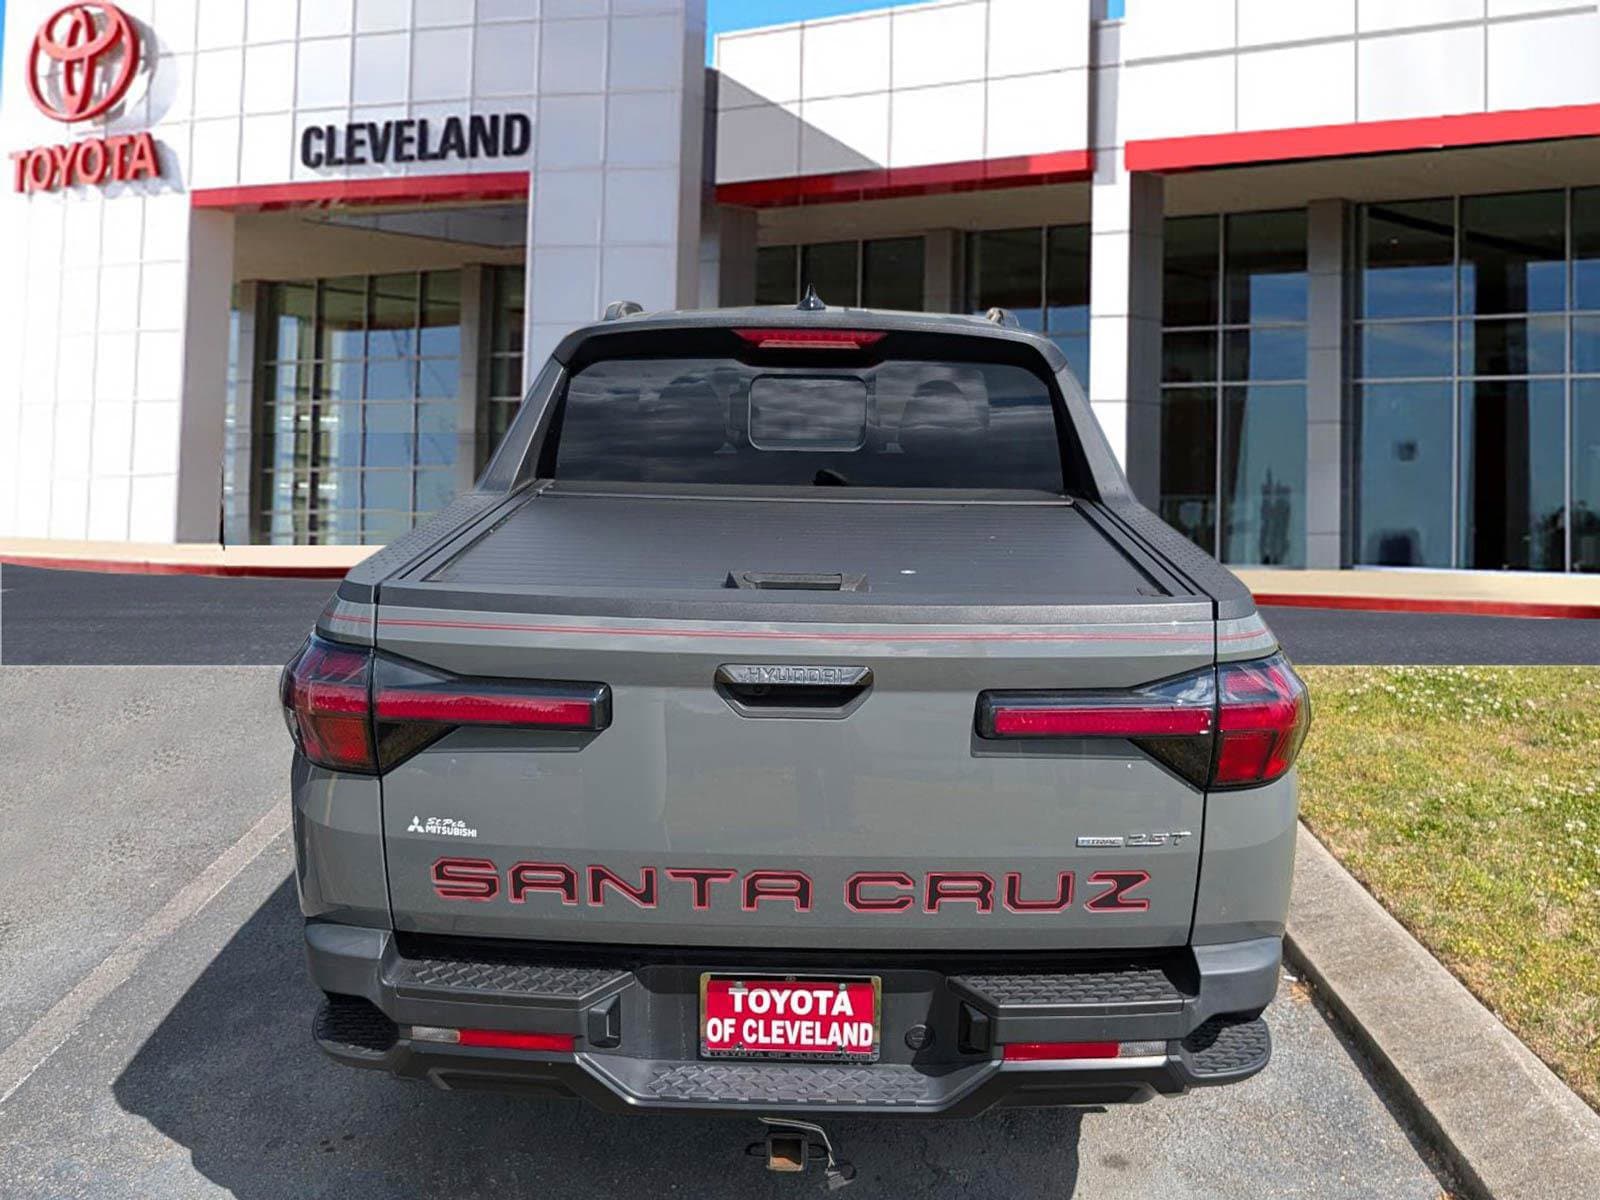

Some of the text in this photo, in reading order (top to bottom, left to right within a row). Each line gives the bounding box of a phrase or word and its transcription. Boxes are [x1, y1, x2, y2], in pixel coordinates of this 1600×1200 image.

[301, 113, 531, 168] CLEVELAND
[9, 132, 161, 193] TOYOTA
[747, 667, 844, 682] HYUNDAI
[425, 825, 477, 837] MITSUBISHI
[430, 858, 1150, 914] SANTA CRUZ
[728, 988, 853, 1016] TOYOTA
[706, 1018, 873, 1047] OF CLEVELAND
